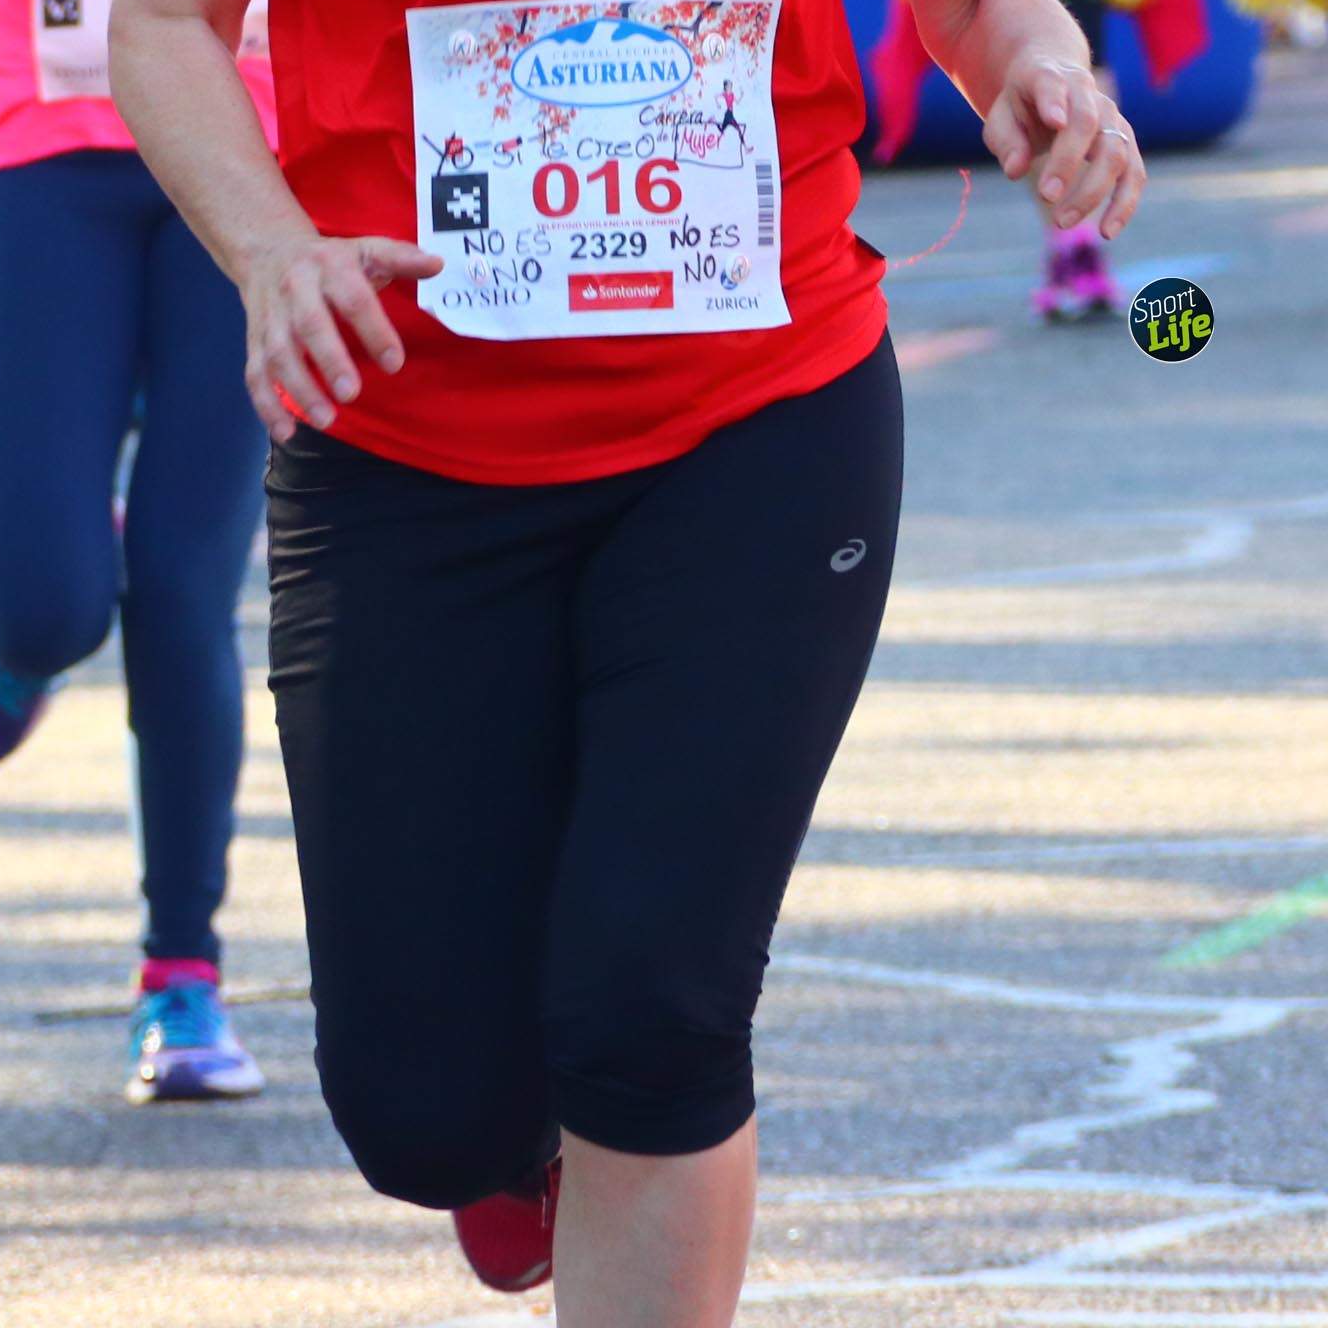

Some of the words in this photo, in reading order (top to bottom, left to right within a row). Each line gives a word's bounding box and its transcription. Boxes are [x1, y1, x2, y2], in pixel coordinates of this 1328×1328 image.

[527, 54, 681, 88] ASTURIANA
[639, 105, 704, 126] Carrera
[680, 123, 721, 160] Mujer
[531, 158, 682, 219] 016
[463, 229, 505, 256] NO
[516, 229, 552, 256] ES
[570, 231, 648, 260] 2329
[669, 214, 701, 250] NO
[710, 224, 741, 248] ES
[492, 257, 543, 286] NO
[684, 252, 717, 283] NO
[442, 287, 531, 308] OYSHO
[598, 283, 662, 300] Santander
[705, 296, 759, 311] ZURICH
